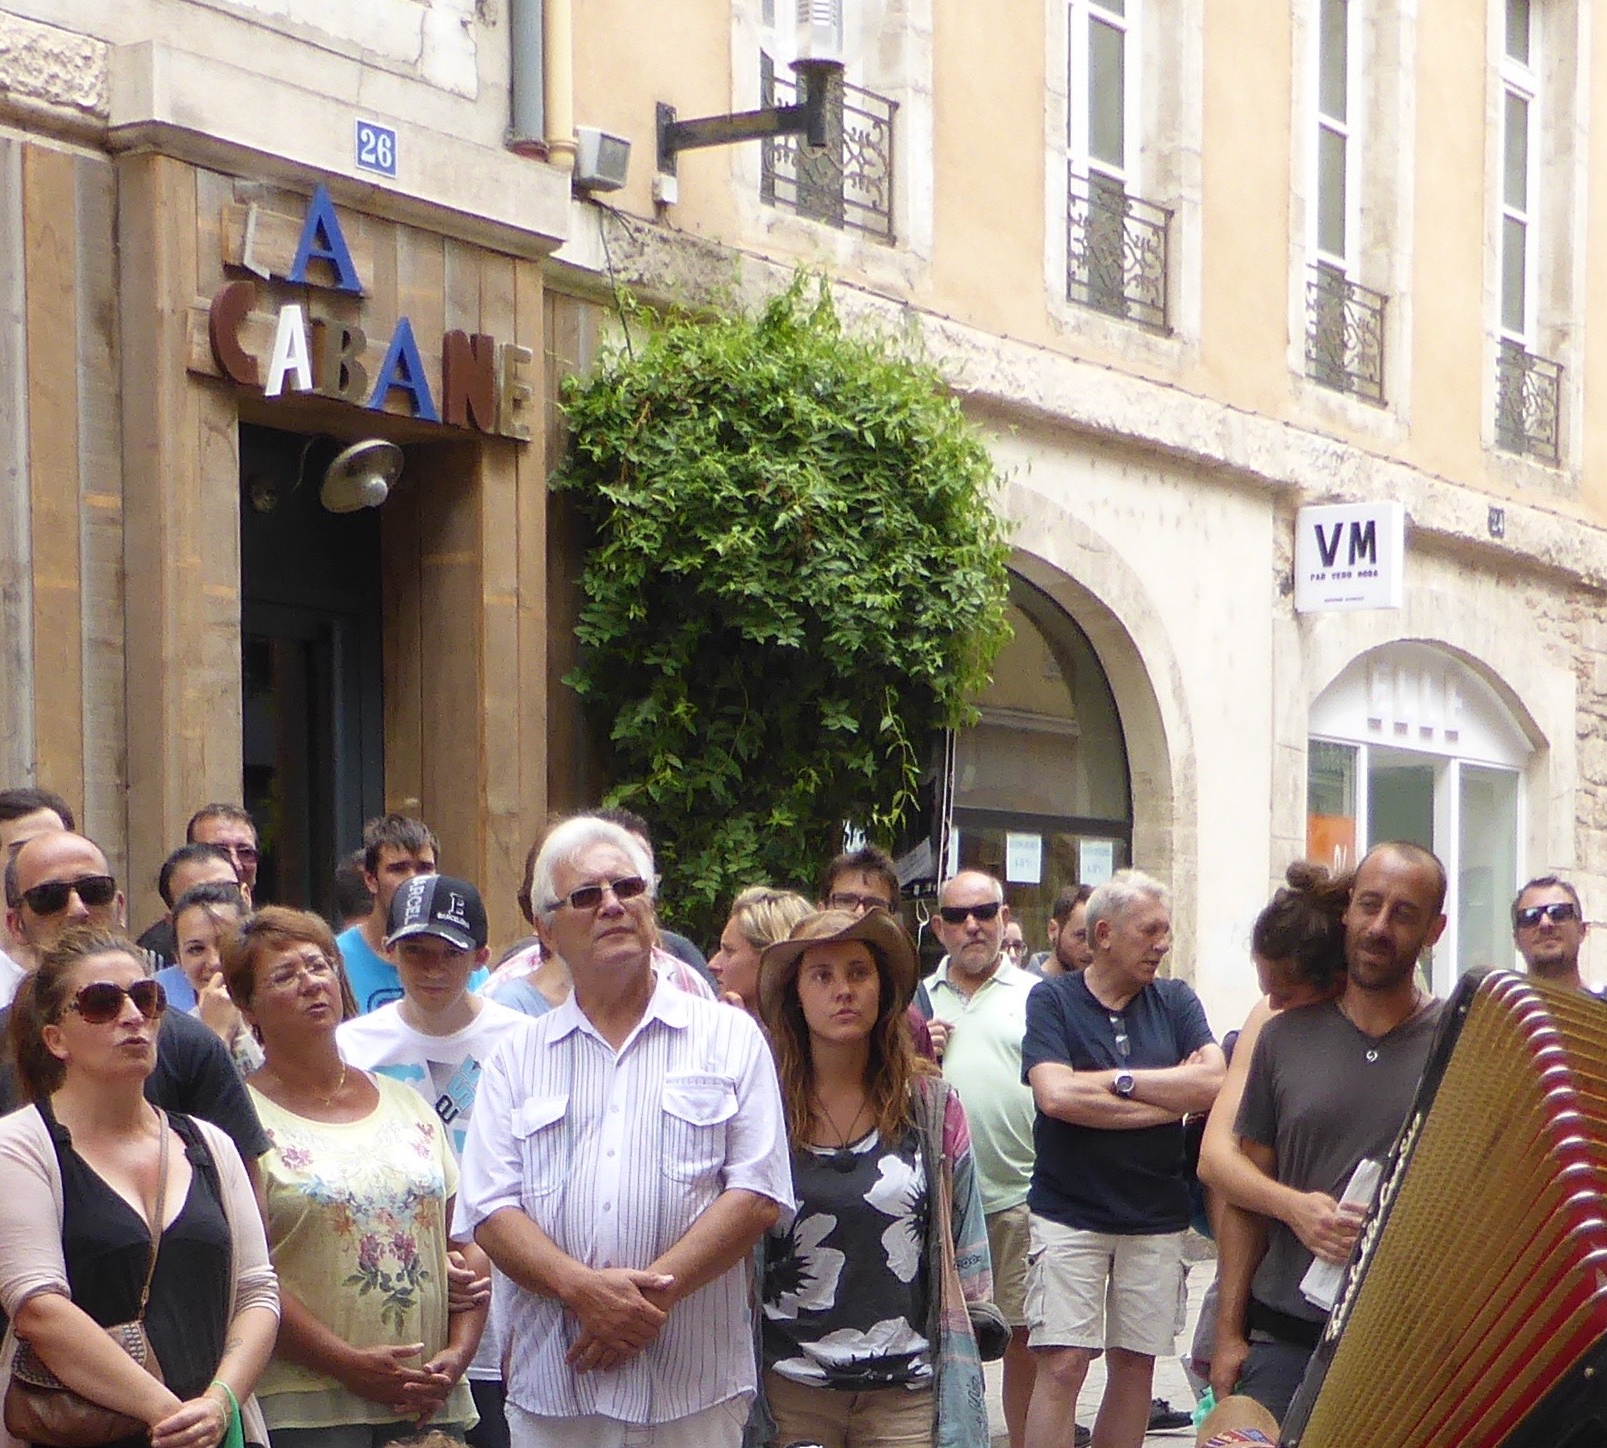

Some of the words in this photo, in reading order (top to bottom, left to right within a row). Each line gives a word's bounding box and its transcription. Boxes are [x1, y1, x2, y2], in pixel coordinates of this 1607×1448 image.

[359, 127, 392, 169] 26
[209, 281, 534, 441] CABANE
[1314, 520, 1377, 568] VM
